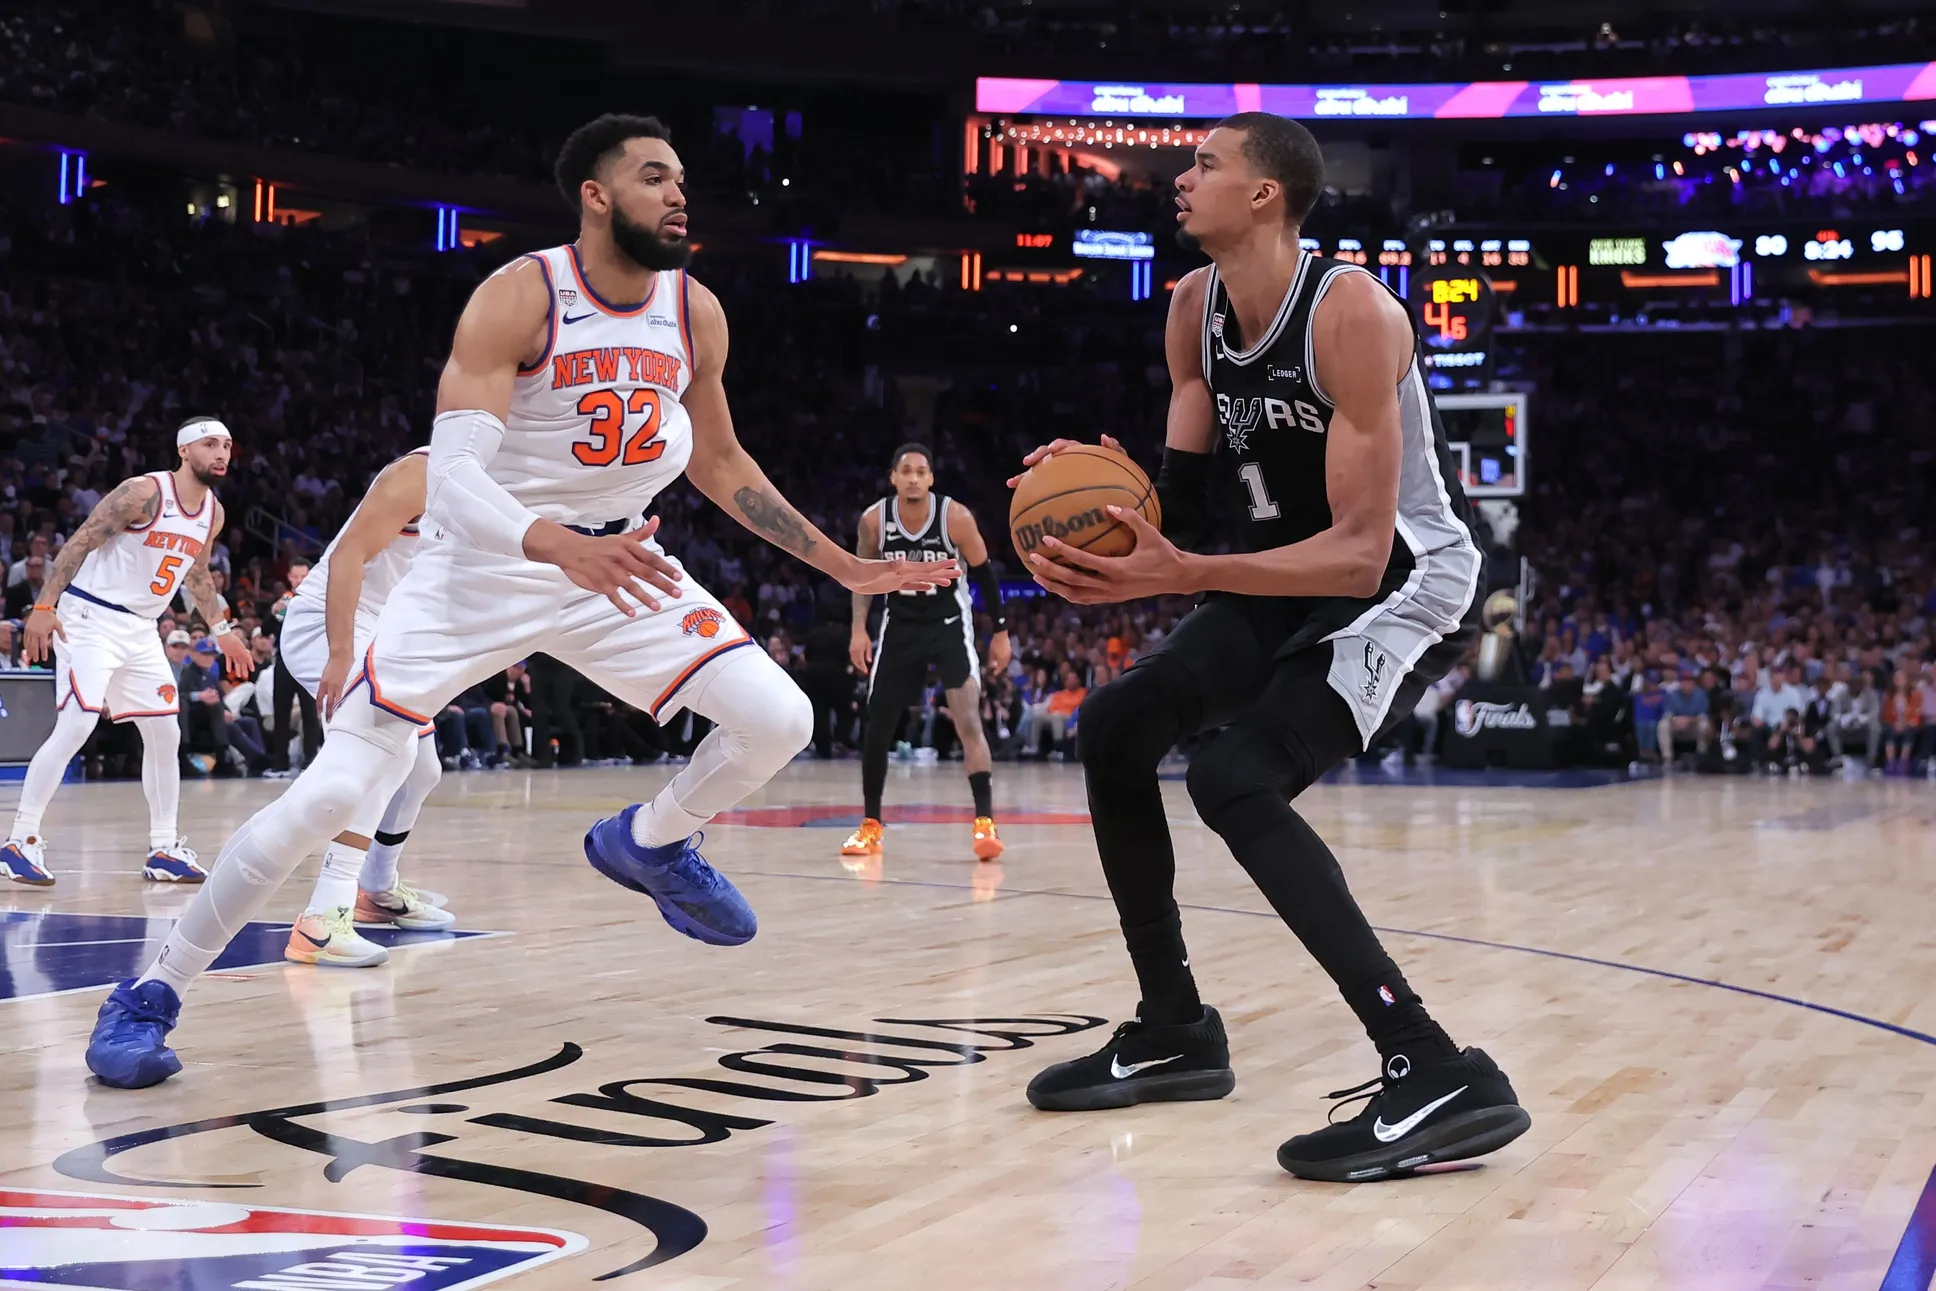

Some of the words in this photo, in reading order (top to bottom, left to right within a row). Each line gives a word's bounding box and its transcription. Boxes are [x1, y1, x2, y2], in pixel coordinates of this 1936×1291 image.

[551, 347, 620, 391] NEW
[621, 347, 682, 395] YORK
[1272, 369, 1297, 378] LEDGER
[572, 388, 668, 468] 32
[1237, 461, 1282, 521] 1
[1015, 508, 1106, 553] Wilson
[150, 555, 184, 597] 5
[1466, 701, 1537, 738] Finals
[53, 1014, 1109, 1281] Finals
